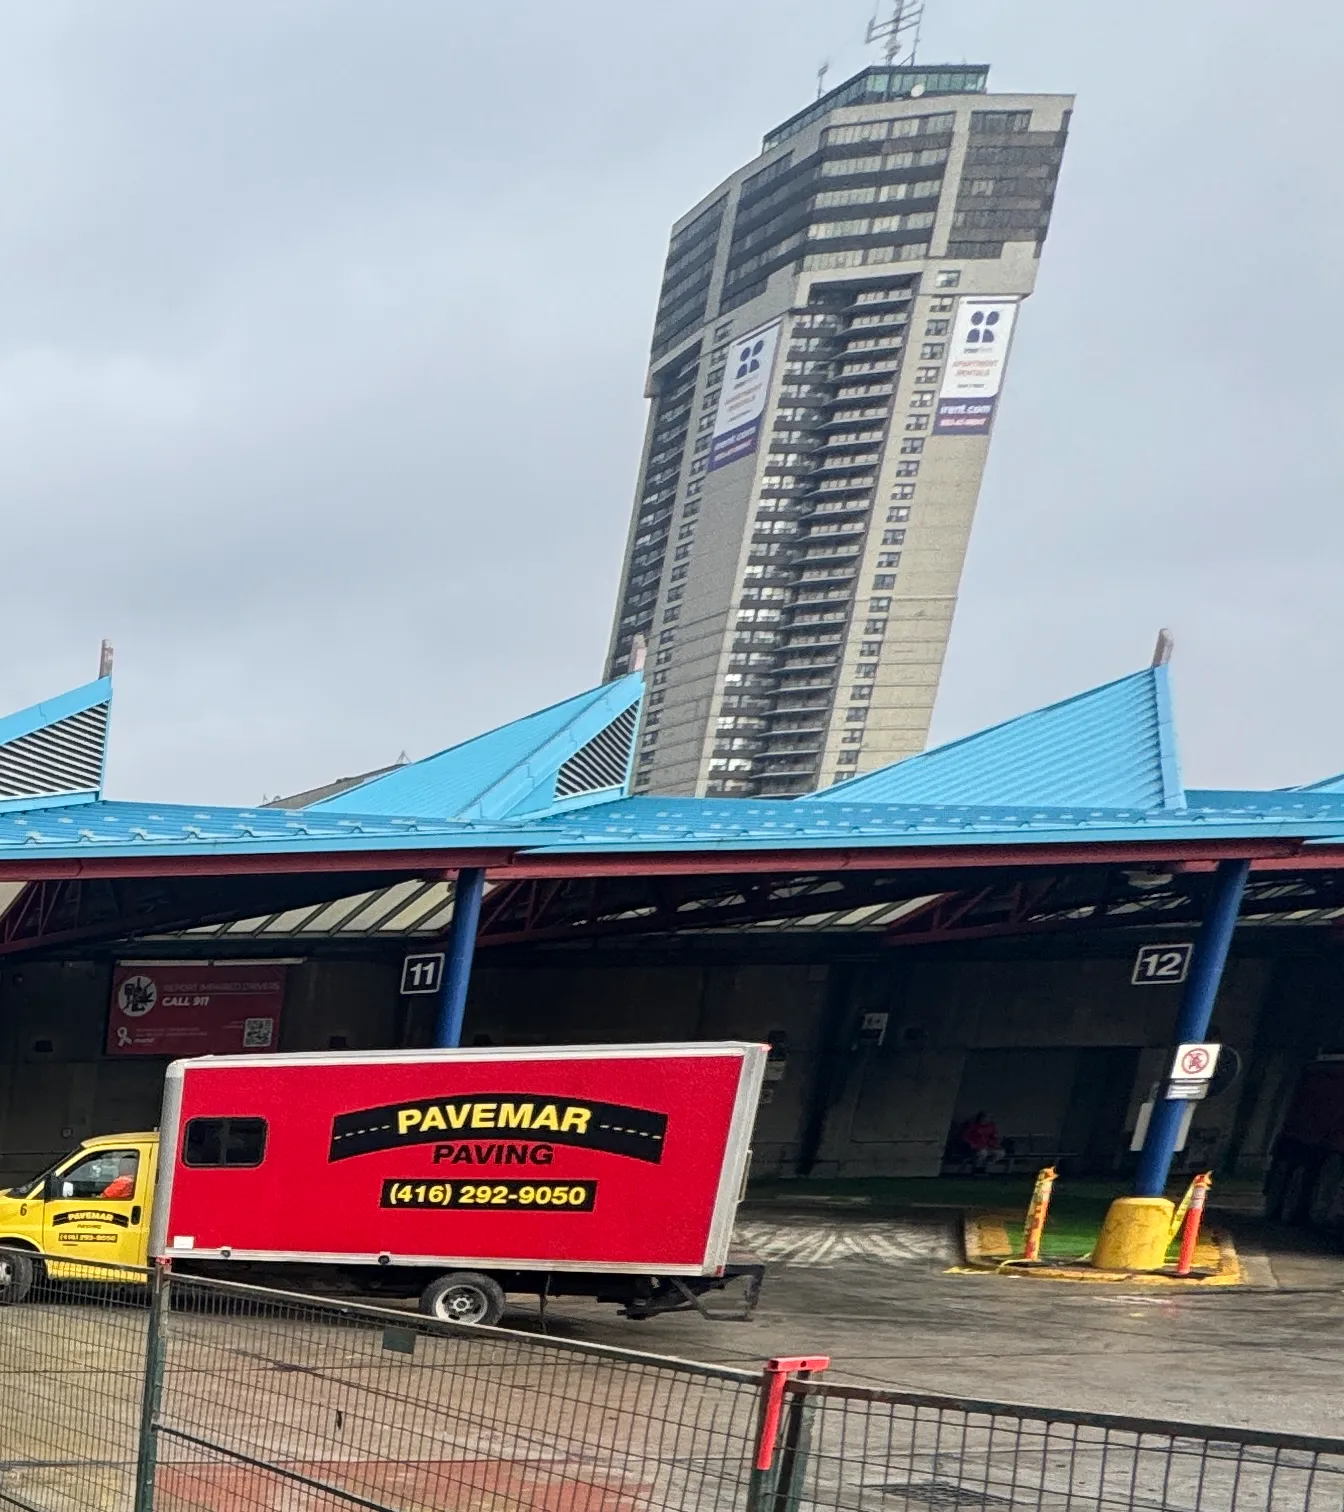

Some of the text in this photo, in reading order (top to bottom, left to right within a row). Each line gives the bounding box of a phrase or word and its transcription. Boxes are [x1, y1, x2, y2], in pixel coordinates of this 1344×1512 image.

[409, 961, 436, 986] 11
[1142, 952, 1182, 977] 12
[162, 996, 190, 1007] CALL
[397, 1102, 592, 1135] PAVEMAR
[432, 1145, 555, 1165] PAVING
[389, 1183, 587, 1206] (416) 292-9050
[20, 1203, 28, 1217] 6
[67, 1211, 115, 1222] PAVEMAR
